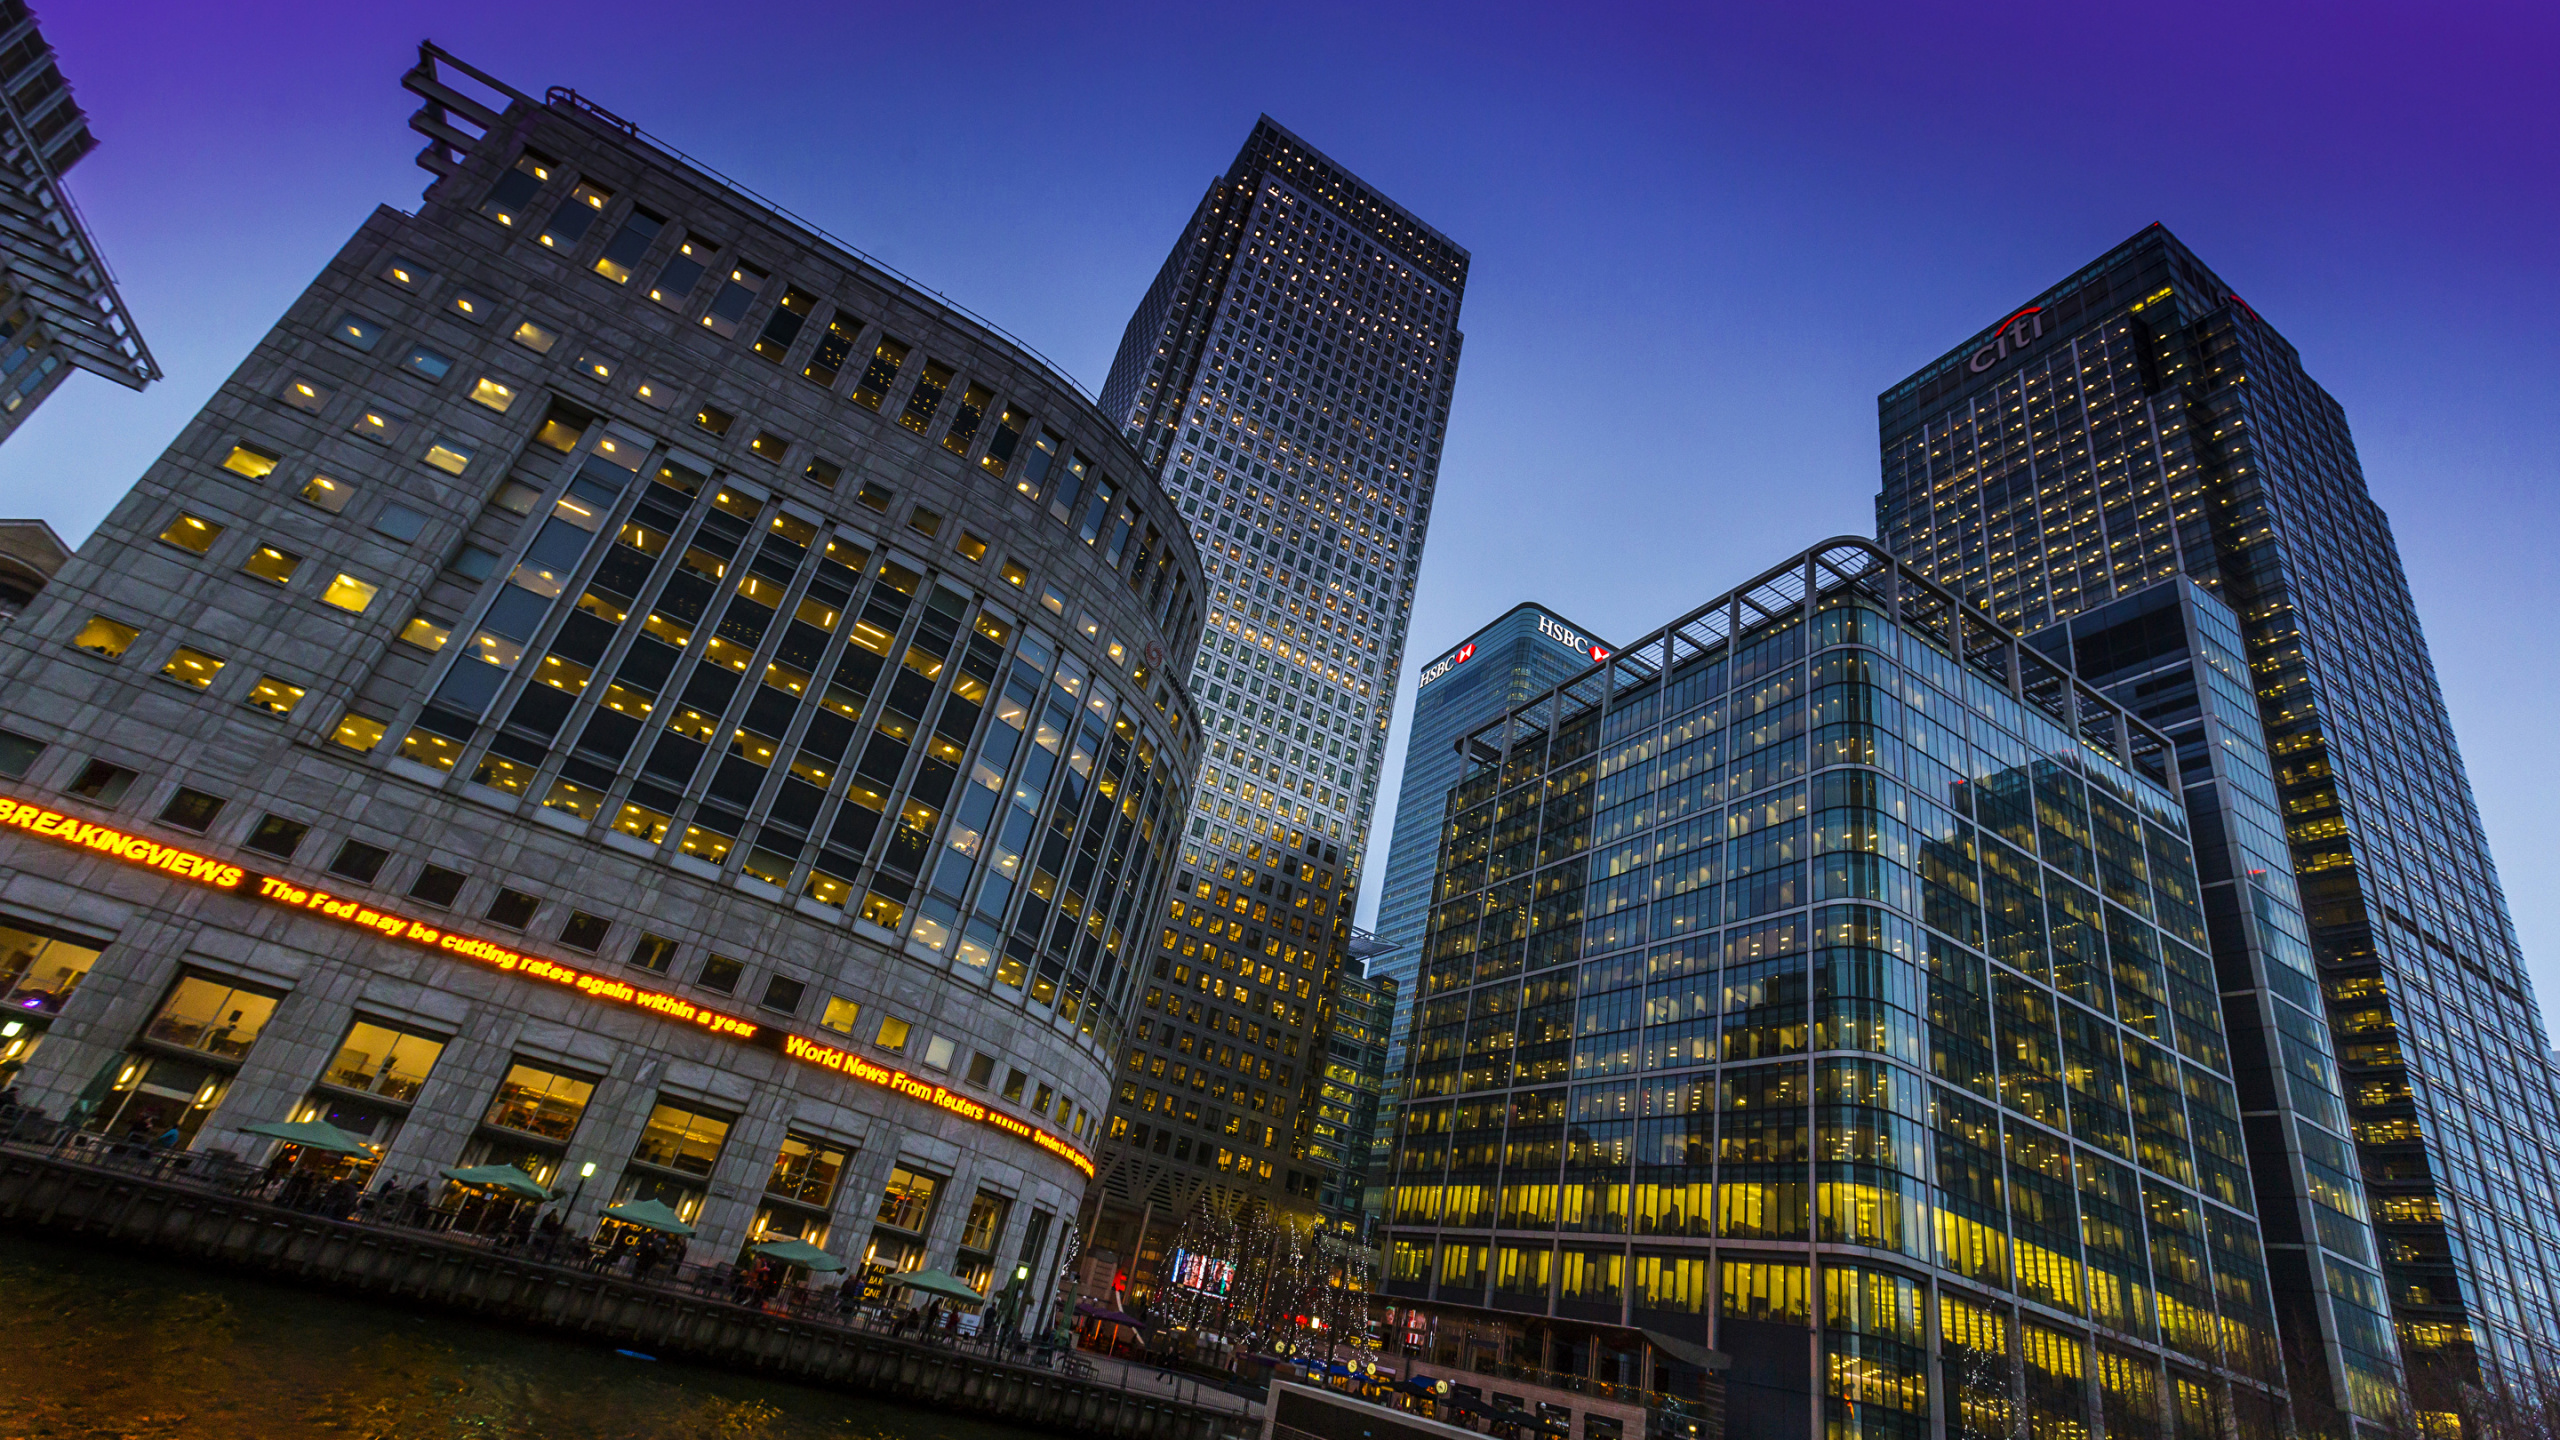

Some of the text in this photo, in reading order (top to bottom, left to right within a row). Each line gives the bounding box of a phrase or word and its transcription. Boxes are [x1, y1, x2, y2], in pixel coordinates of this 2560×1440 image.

[1969, 306, 2043, 373] citi
[1537, 614, 1589, 655] HSBC
[1418, 654, 1456, 689] HSBC
[0, 798, 244, 888] BREAKINGVIEWS
[259, 876, 758, 1038] The Fed may be cutting rates again within a year
[785, 1034, 985, 1120] World News From Reuters
[1033, 1129, 1061, 1153] Sweden
[867, 1275, 884, 1287] BAR
[873, 1264, 887, 1275] ALL
[863, 1287, 881, 1299] ONE
